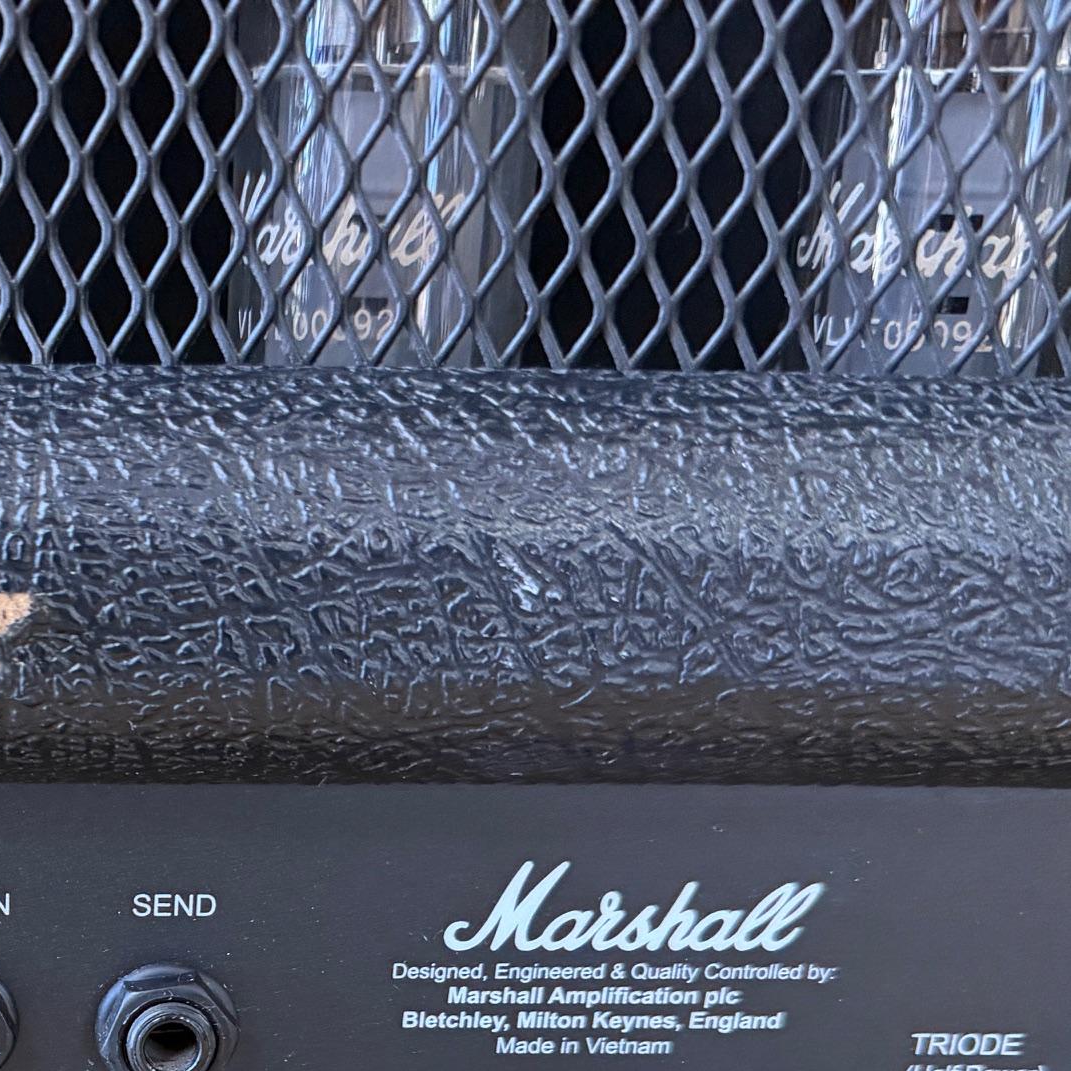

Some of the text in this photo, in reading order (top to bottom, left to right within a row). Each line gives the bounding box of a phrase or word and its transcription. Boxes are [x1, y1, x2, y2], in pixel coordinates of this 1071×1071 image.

[132, 894, 217, 917] SEND
[443, 860, 825, 952] Marshall
[392, 962, 837, 983] Designed, Engineered & Quality Controlled by:
[447, 986, 741, 1008] Marshall Amplification plc
[402, 1010, 786, 1033] Bletchley, Milton Keynes, England
[495, 1036, 673, 1055] Made in Vietnam
[911, 1033, 1026, 1056] TRIODE
